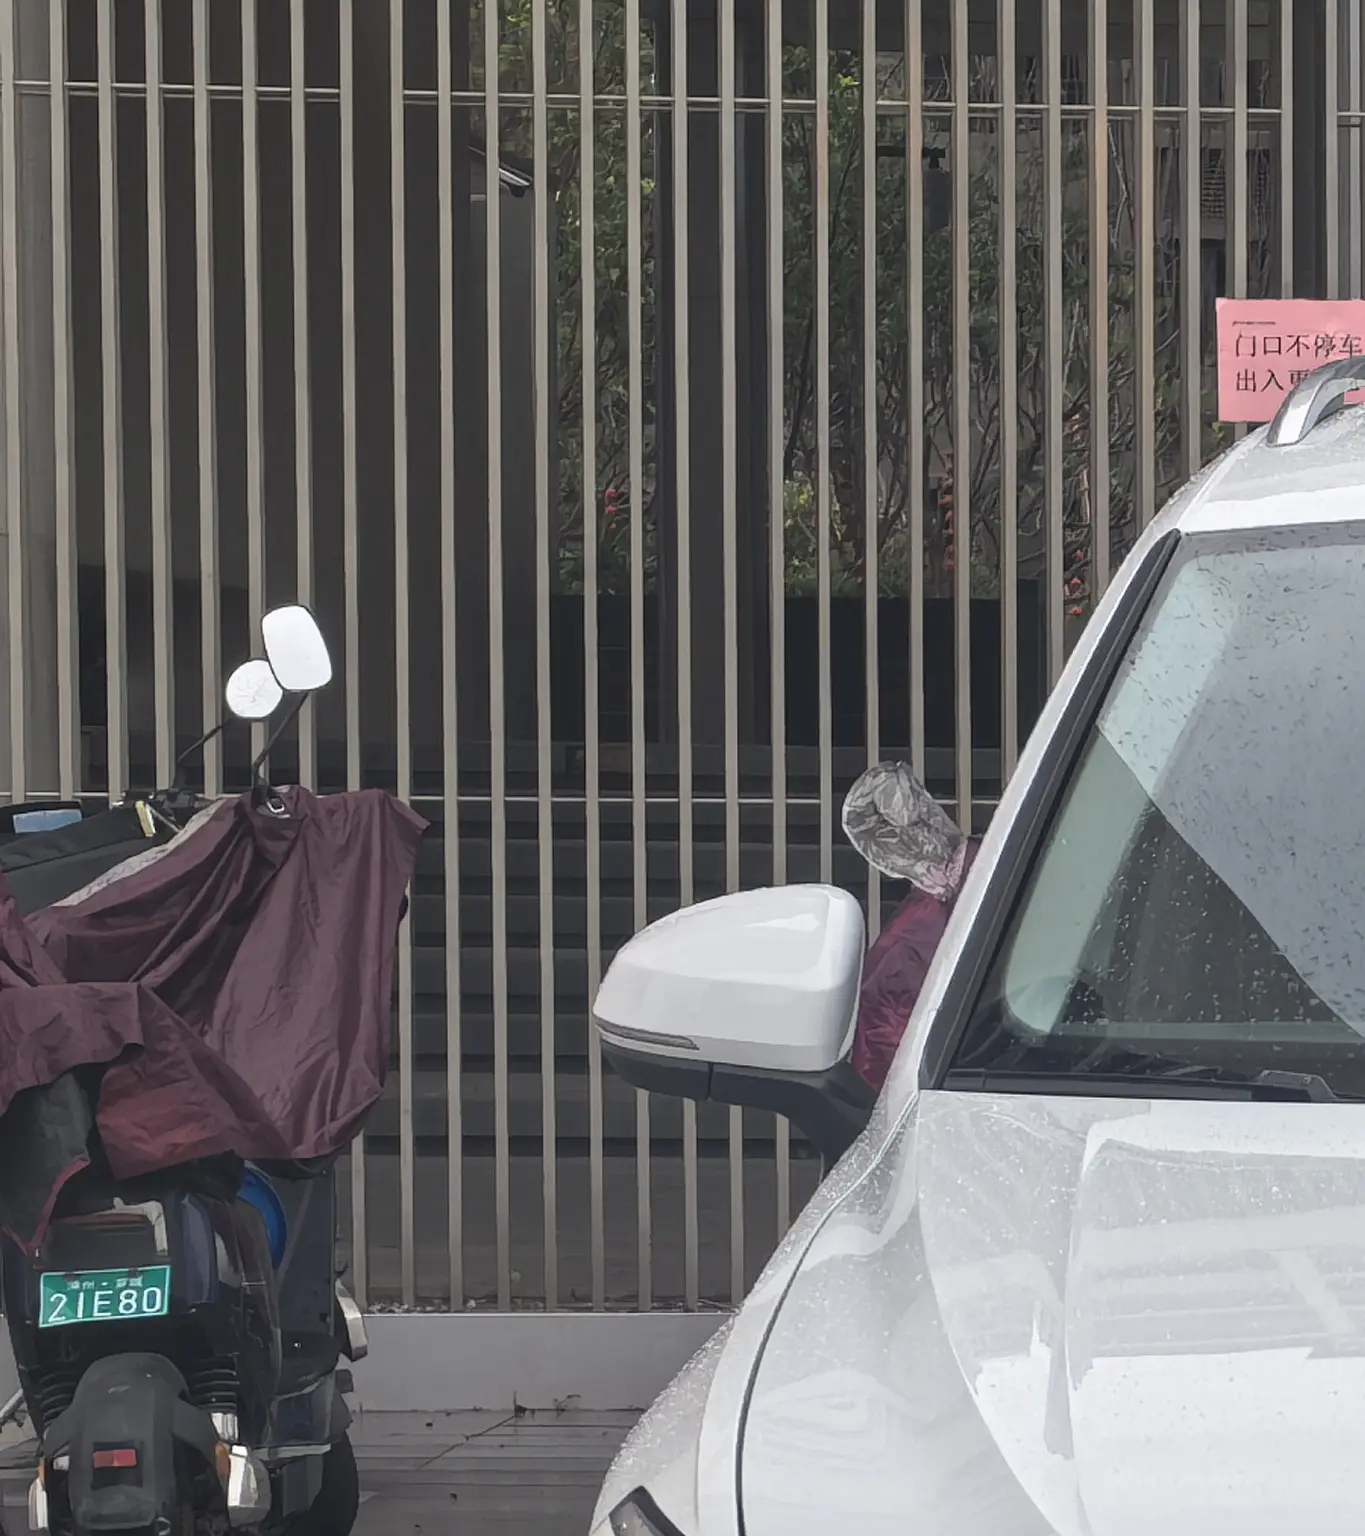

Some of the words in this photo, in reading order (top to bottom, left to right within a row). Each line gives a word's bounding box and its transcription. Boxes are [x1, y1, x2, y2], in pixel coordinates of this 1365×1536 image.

[1235, 332, 1363, 359] 门口不停车
[47, 1286, 162, 1323] 21E80
